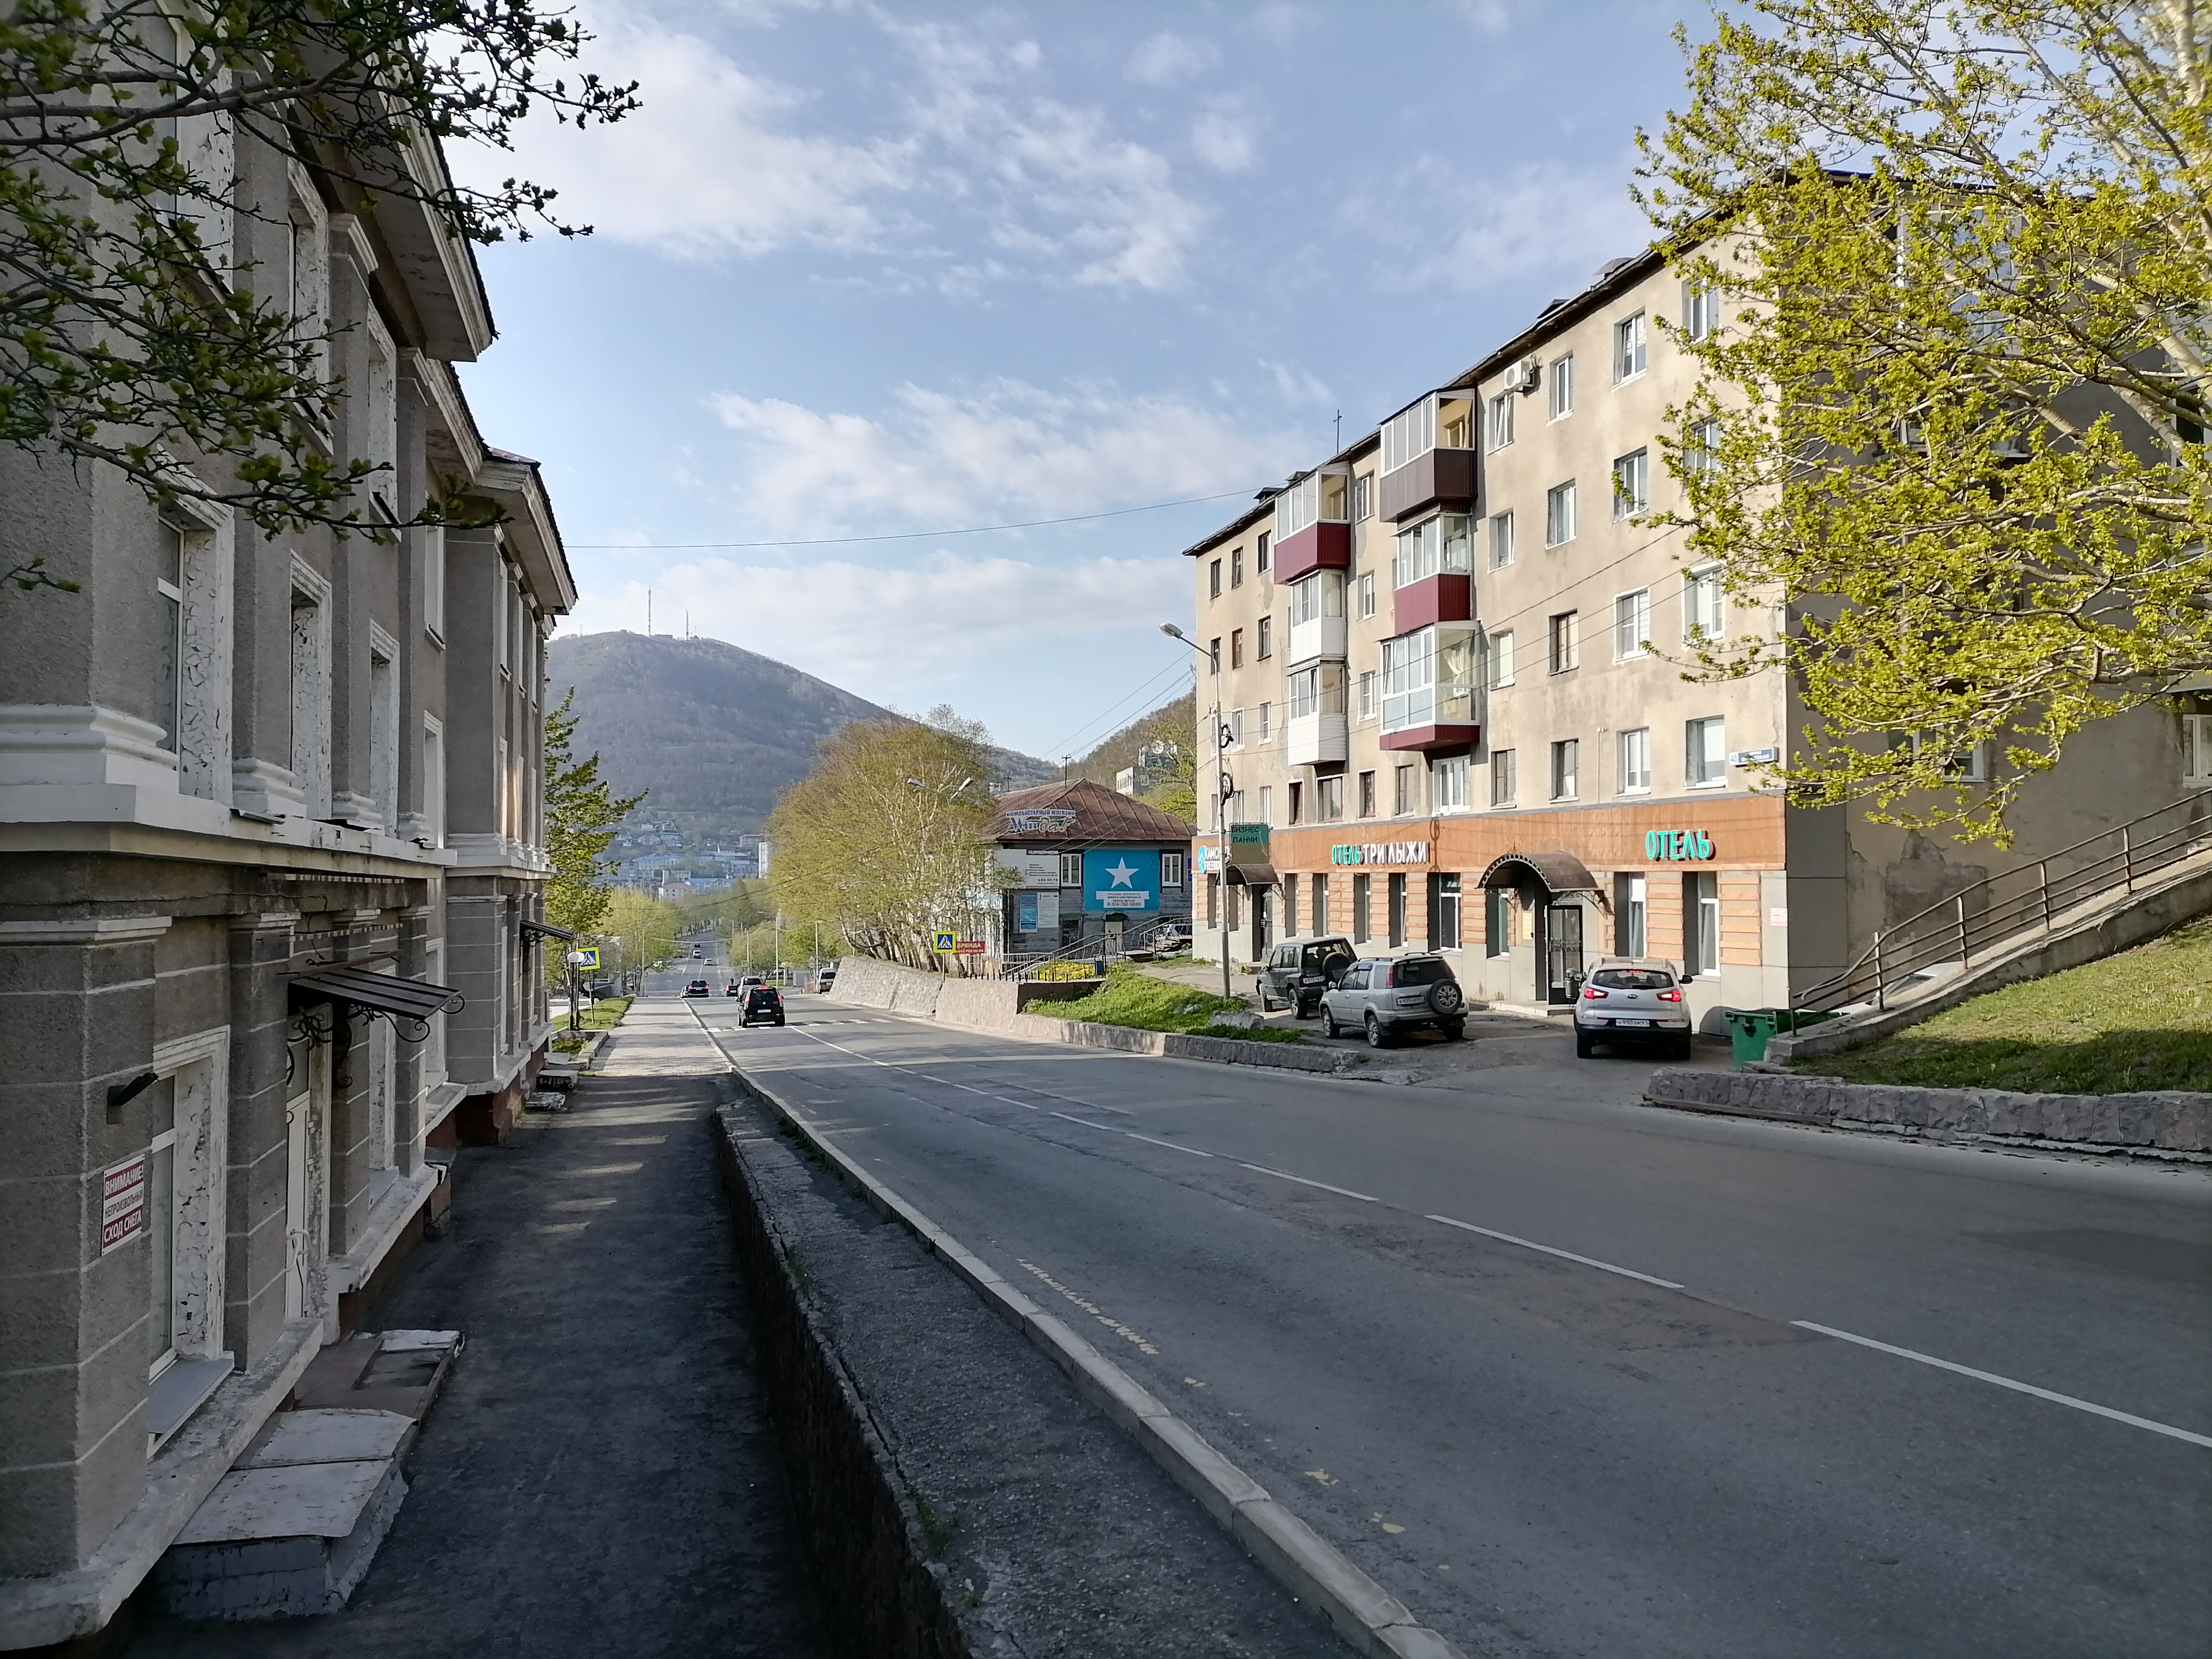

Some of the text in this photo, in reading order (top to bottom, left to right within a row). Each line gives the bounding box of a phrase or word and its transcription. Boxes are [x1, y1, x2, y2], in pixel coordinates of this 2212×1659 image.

[1332, 841, 1426, 864] ОТЕЛЬ ТРИ ЛЫЖИ
[1646, 829, 1711, 860] ОТЕЛЬ
[105, 1164, 144, 1197] ВНИМАНИЕ!
[105, 1188, 143, 1219] НЕПРОИЗВОЛЬНЫЙ
[104, 1209, 142, 1243] СХОД СНЕГА
